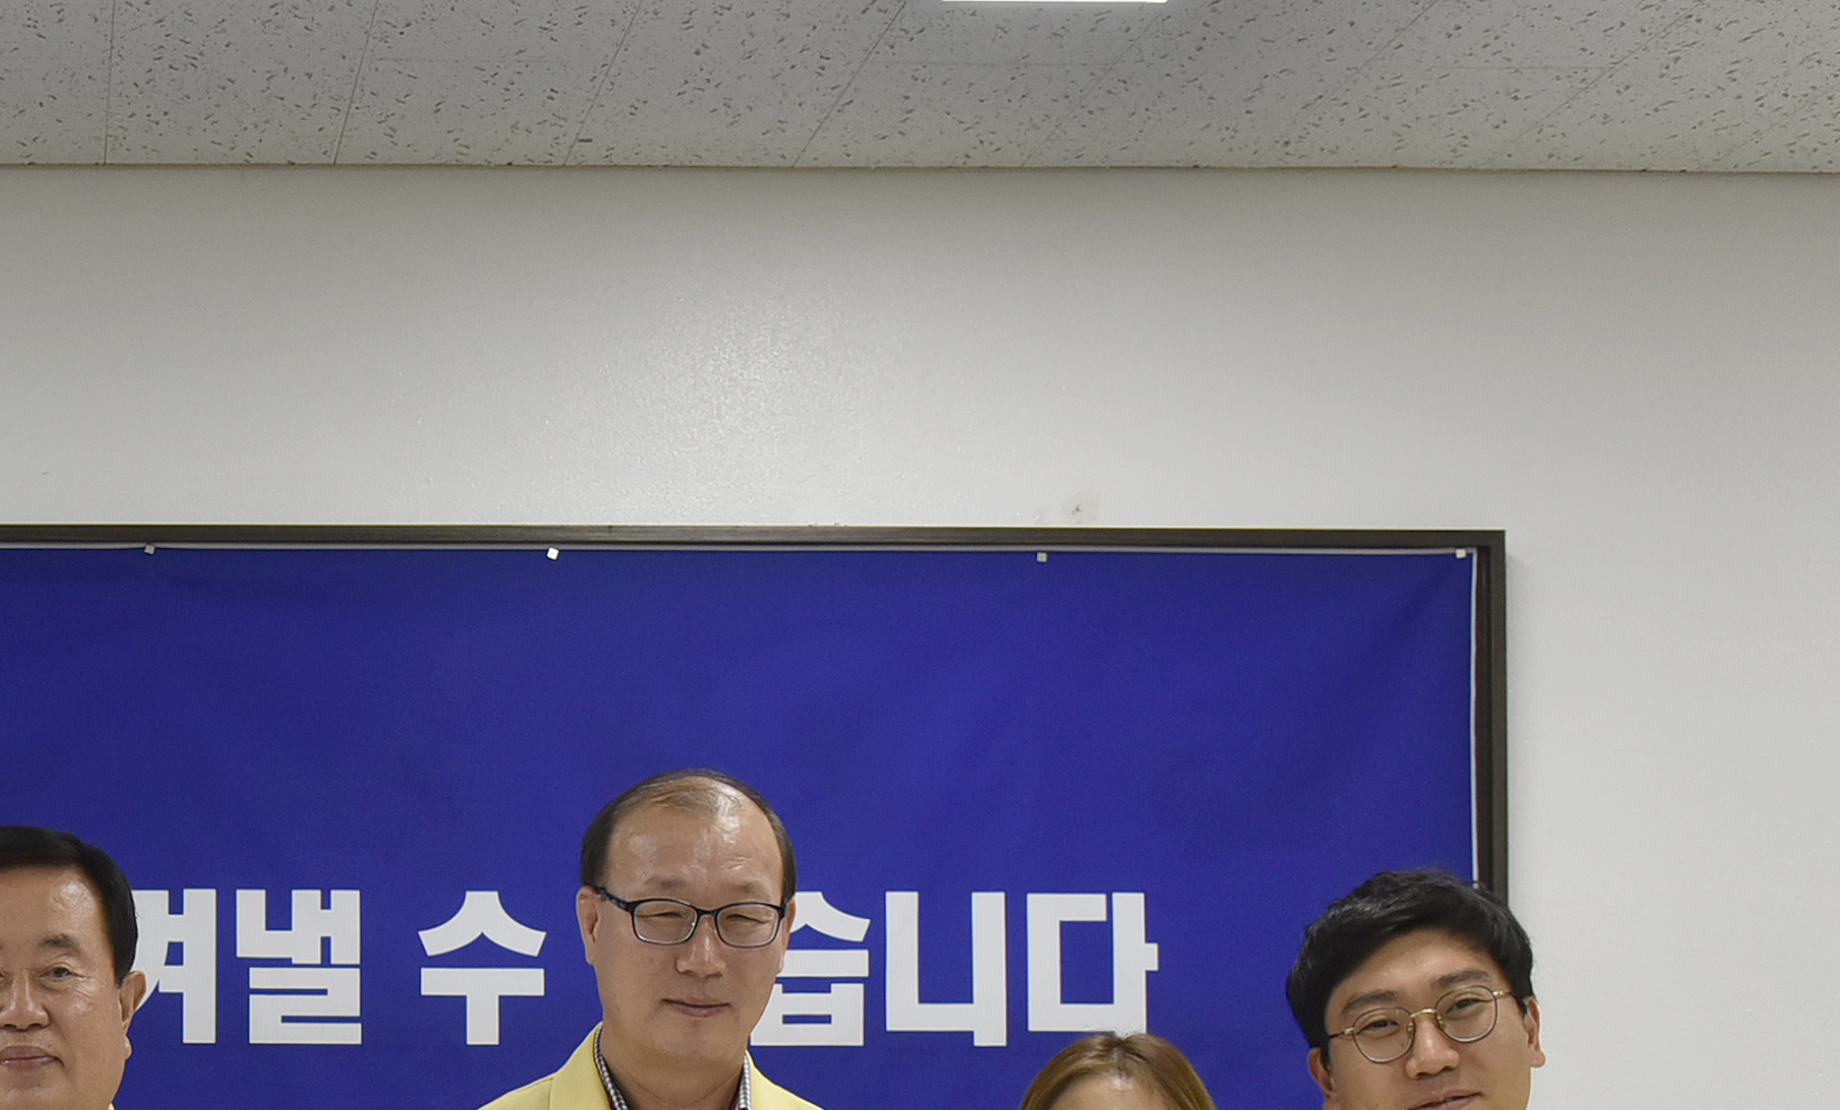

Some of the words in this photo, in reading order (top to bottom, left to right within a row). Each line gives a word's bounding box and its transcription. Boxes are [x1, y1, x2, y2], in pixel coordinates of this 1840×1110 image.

[131, 888, 362, 1044] 겨낼
[418, 891, 547, 1045] 수
[750, 891, 1159, 1046] 습니다
